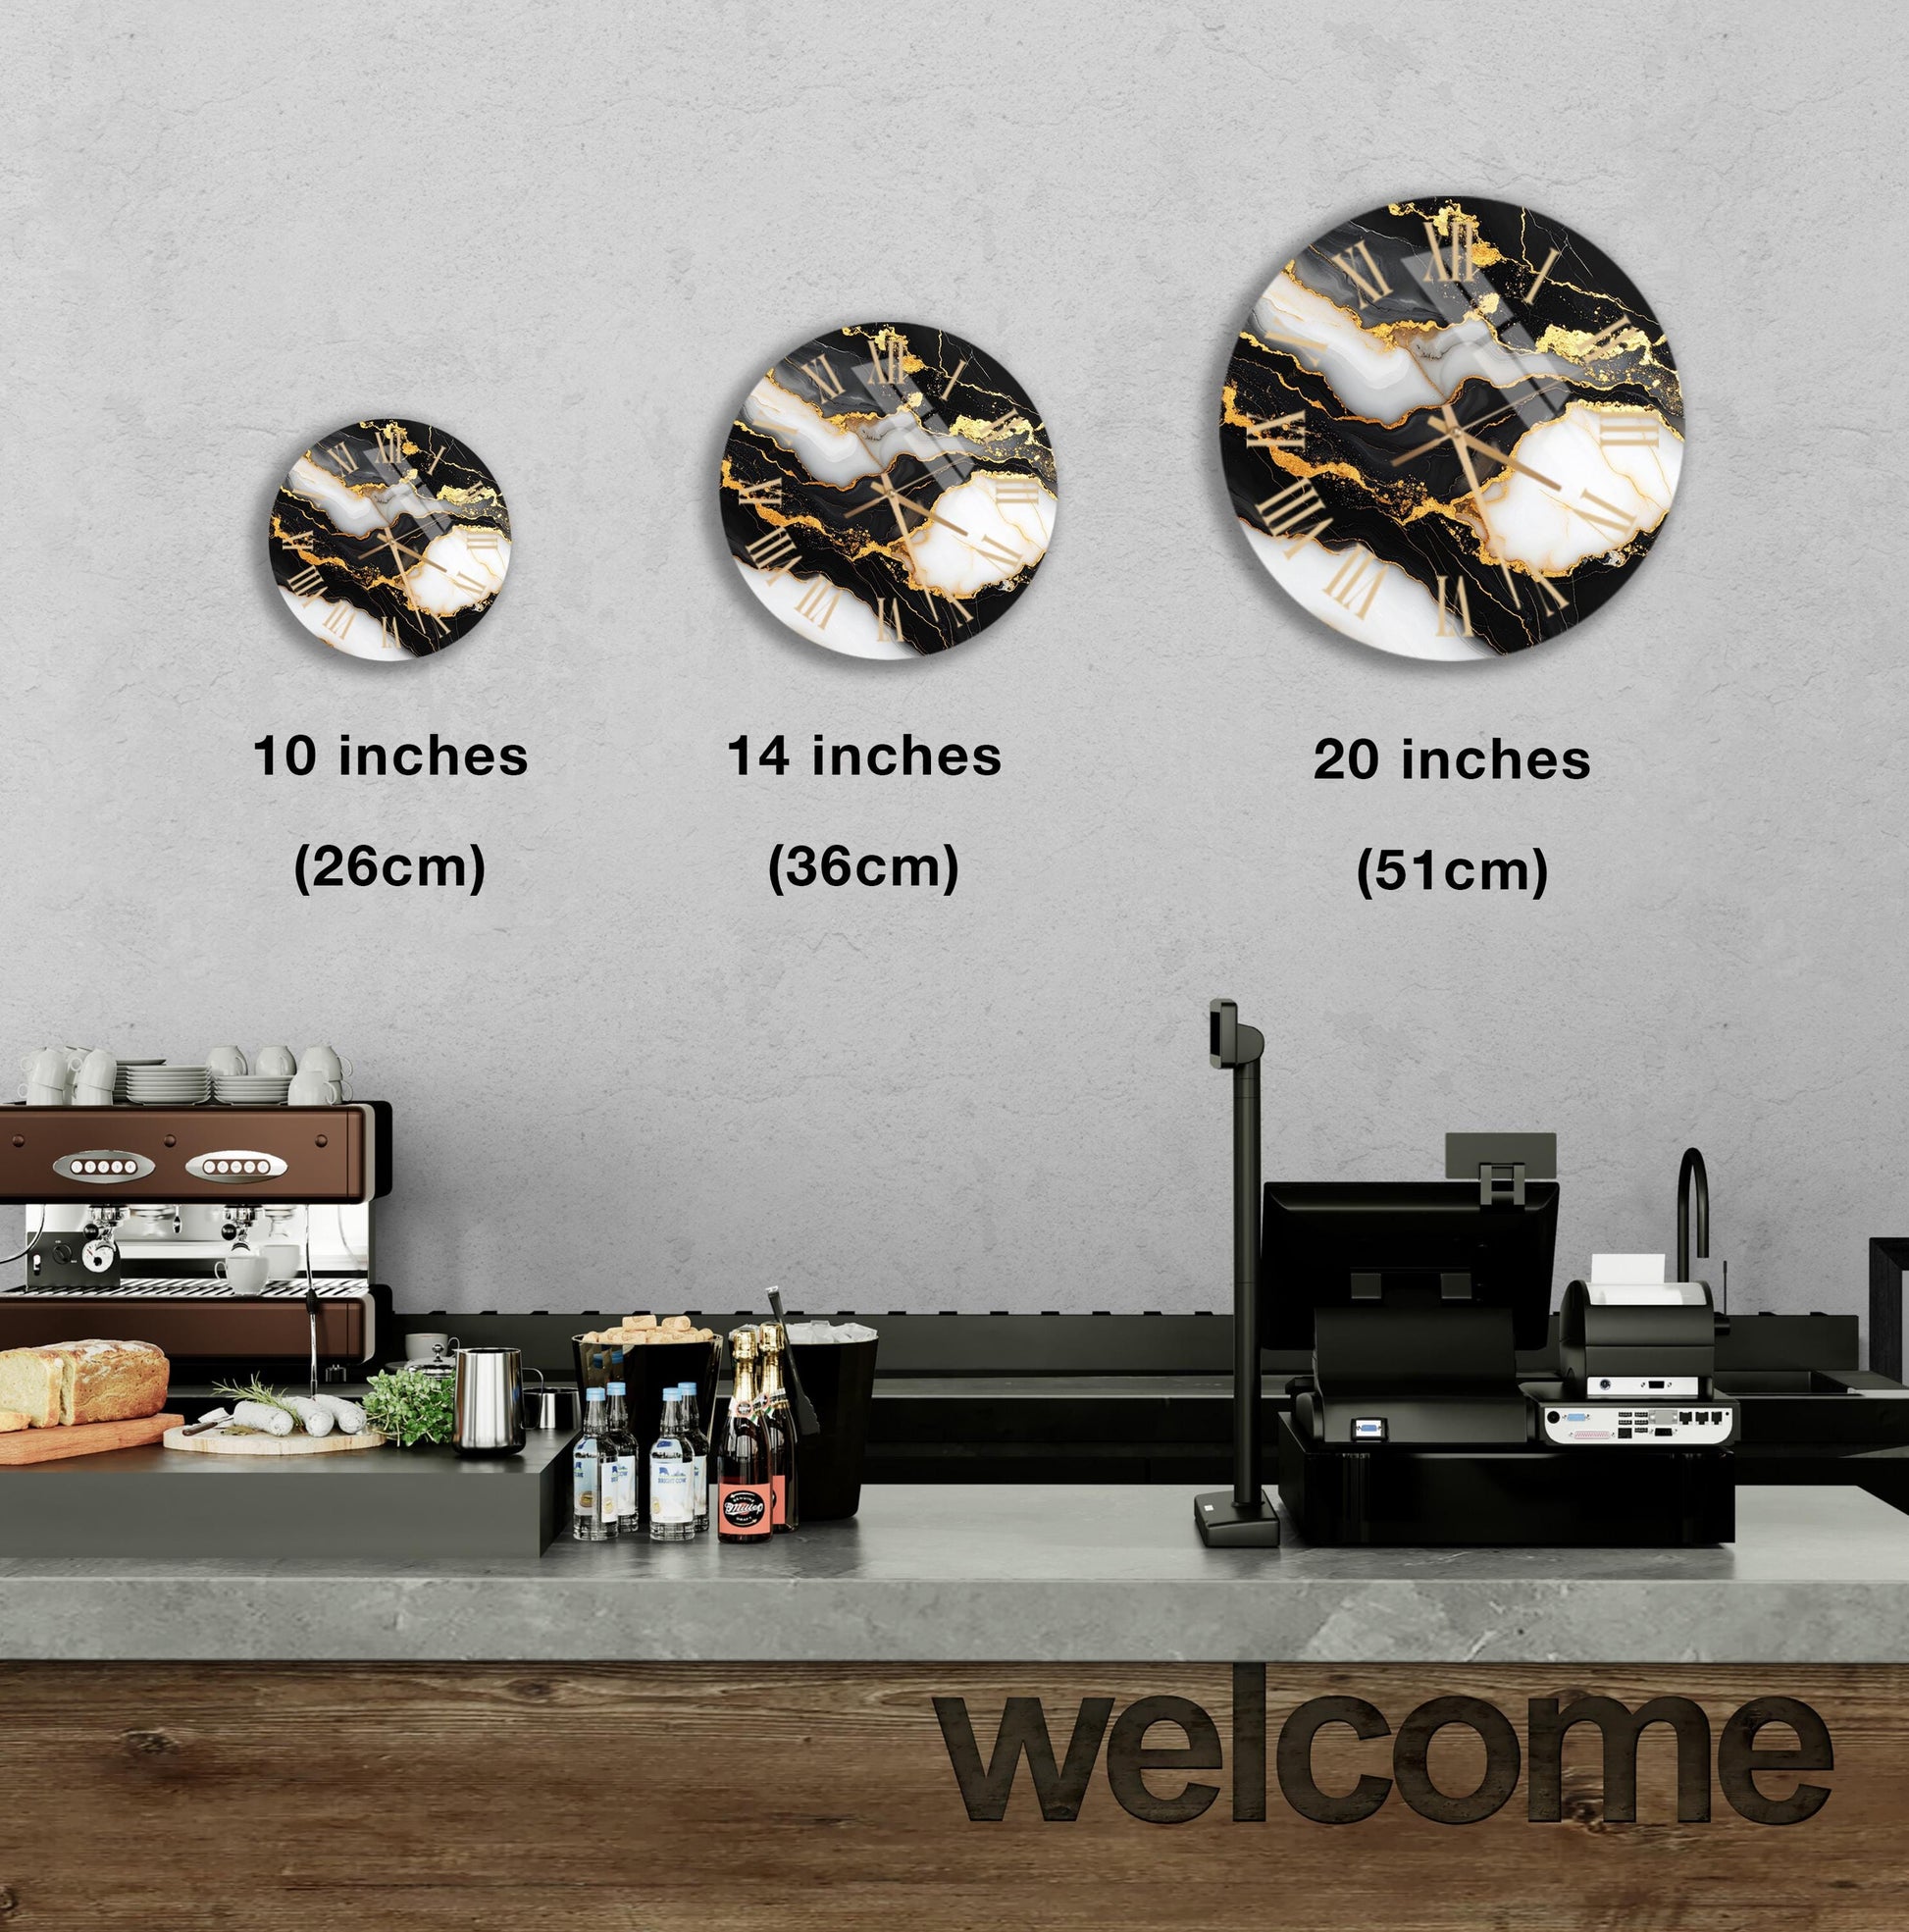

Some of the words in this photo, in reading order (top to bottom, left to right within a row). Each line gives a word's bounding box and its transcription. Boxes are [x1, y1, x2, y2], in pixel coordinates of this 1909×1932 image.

[1423, 222, 1474, 283] XII
[1523, 247, 1560, 305] I
[1599, 410, 1659, 447] III
[931, 1662, 1834, 1824] welcome
